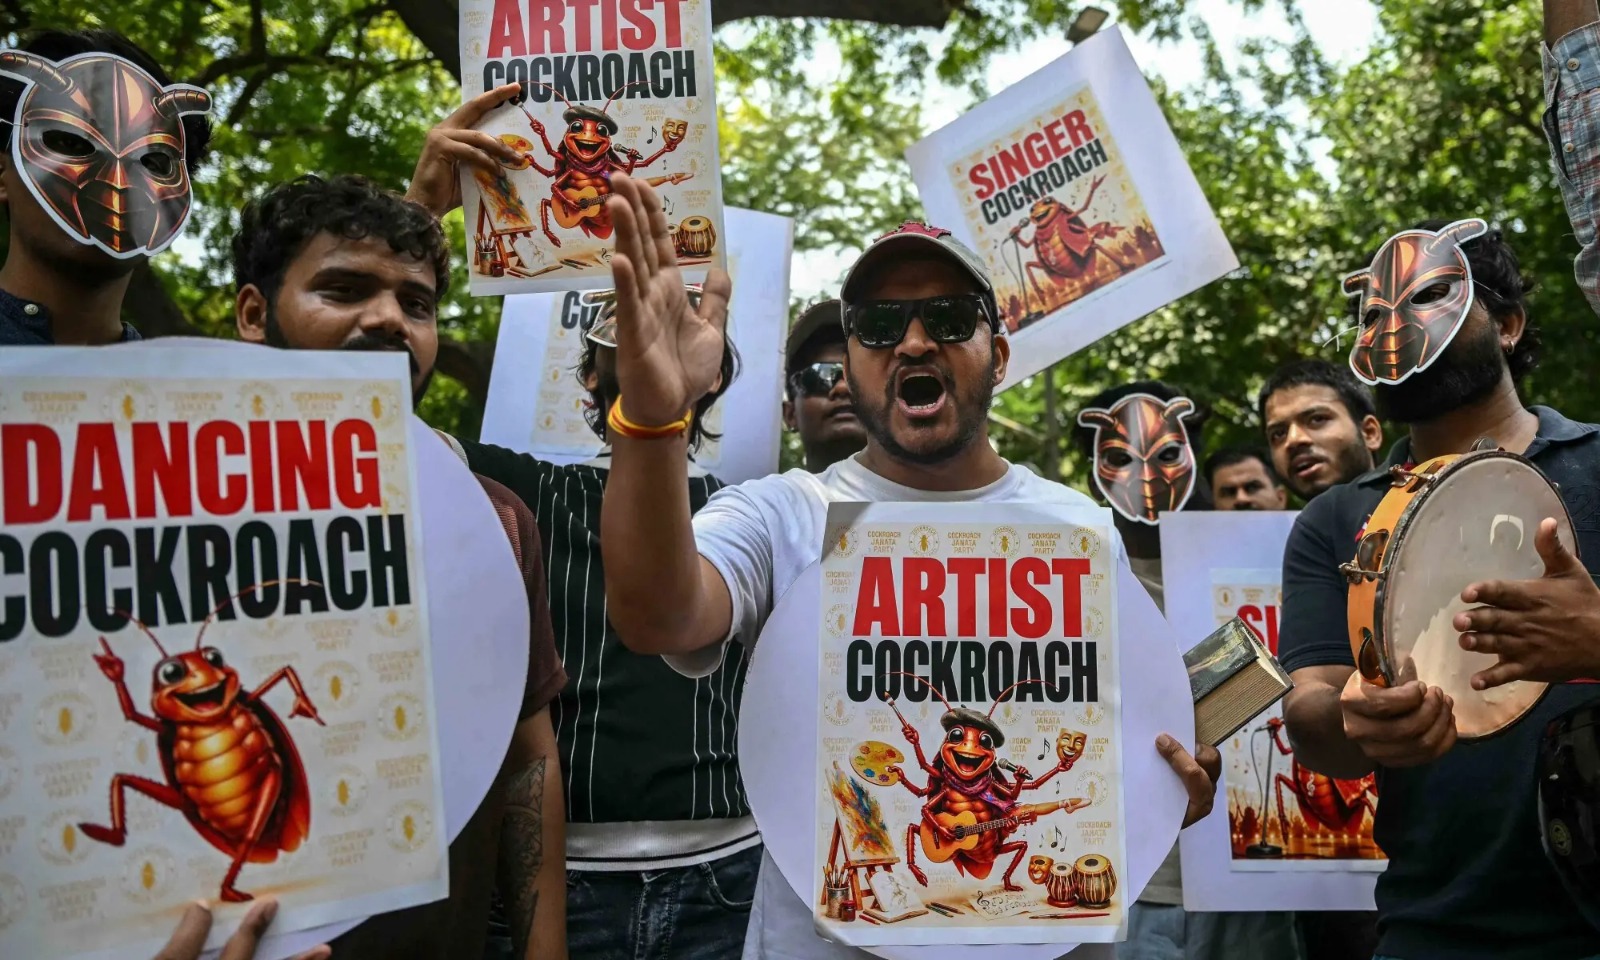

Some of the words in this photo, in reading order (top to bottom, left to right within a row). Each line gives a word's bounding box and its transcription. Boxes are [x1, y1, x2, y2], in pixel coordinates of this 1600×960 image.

[487, 0, 689, 58] ARTIST
[484, 50, 697, 107] COCKROACH
[969, 109, 1095, 200] SINGER
[981, 139, 1108, 225] COCKROACH
[1, 418, 381, 525] DANCING
[867, 530, 902, 538] COCKROACH
[871, 538, 897, 546] JANATA
[947, 532, 981, 540] COCKROACH
[951, 539, 977, 547] JANATA
[1027, 532, 1061, 540] COCKROACH
[1031, 540, 1057, 548] JANATA
[852, 556, 1090, 638] ARTIST
[846, 639, 1099, 703] COCKROACH
